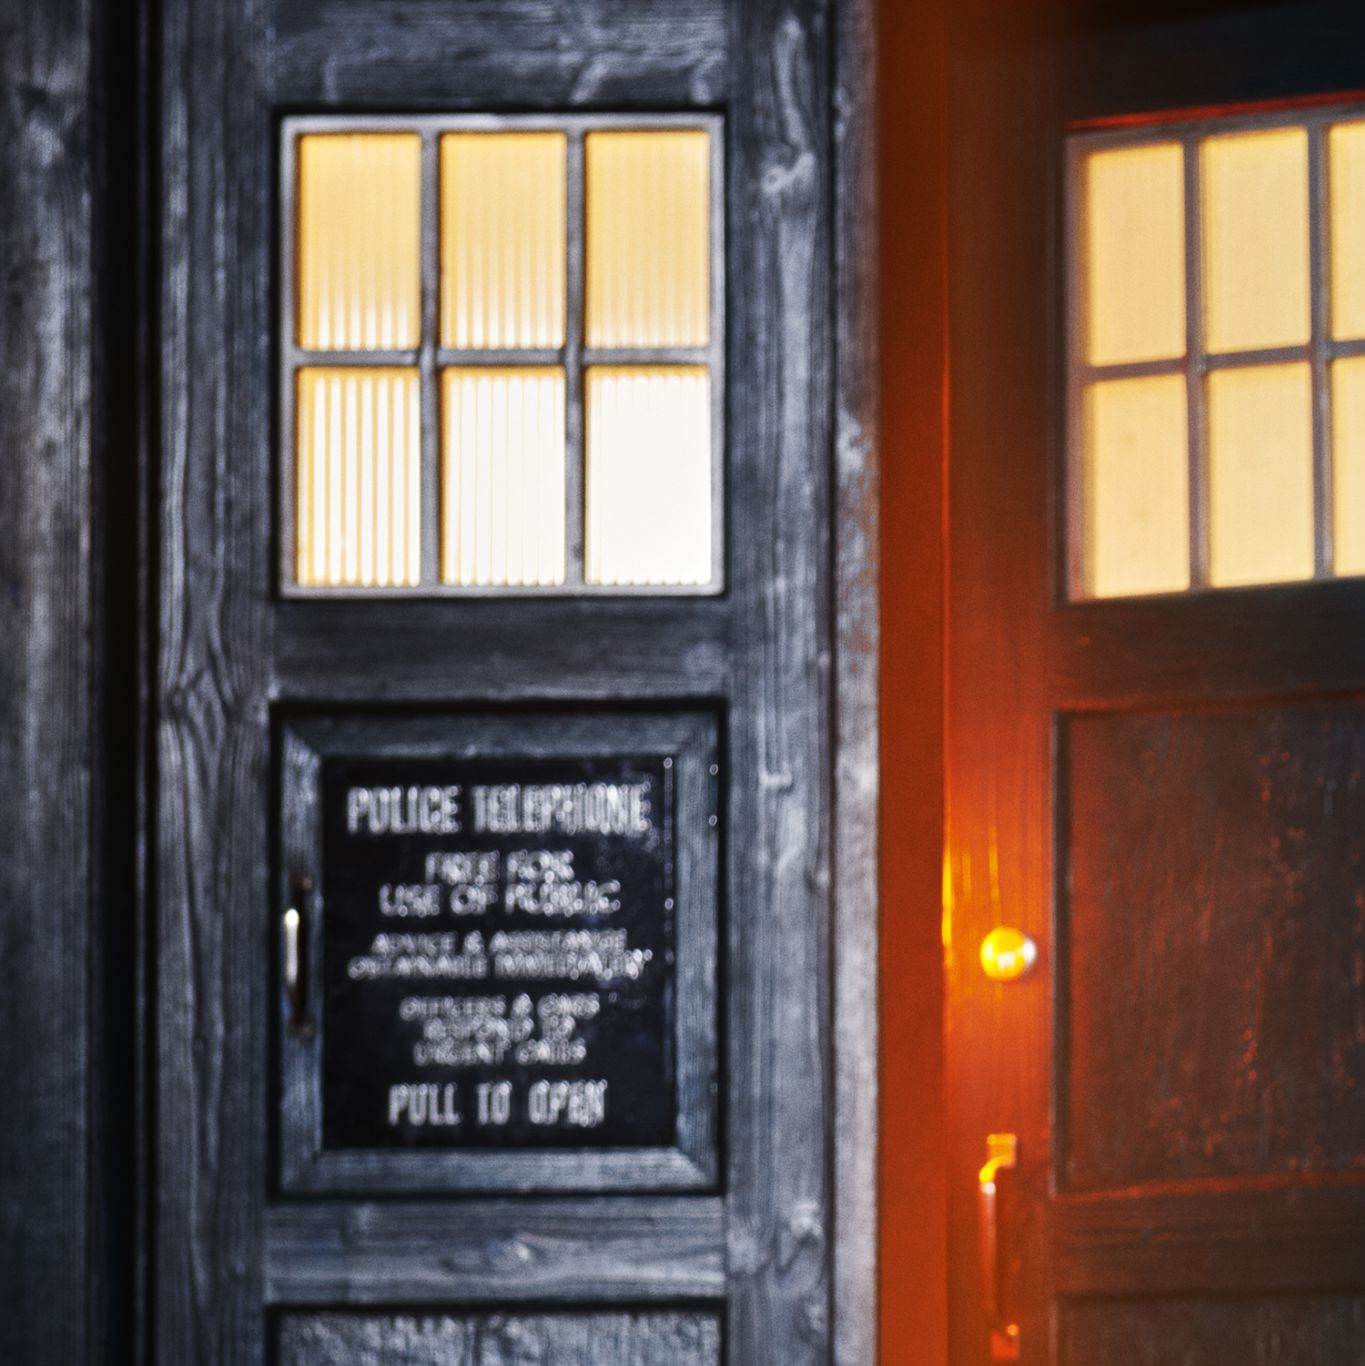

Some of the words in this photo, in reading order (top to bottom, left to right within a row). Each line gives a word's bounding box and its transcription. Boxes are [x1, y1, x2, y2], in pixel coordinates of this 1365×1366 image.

[346, 785, 460, 835] POLICE
[473, 783, 650, 835] TELEPHONE
[388, 1083, 461, 1126] PULL
[476, 1081, 511, 1125] TO
[528, 1080, 606, 1127] OPEN
